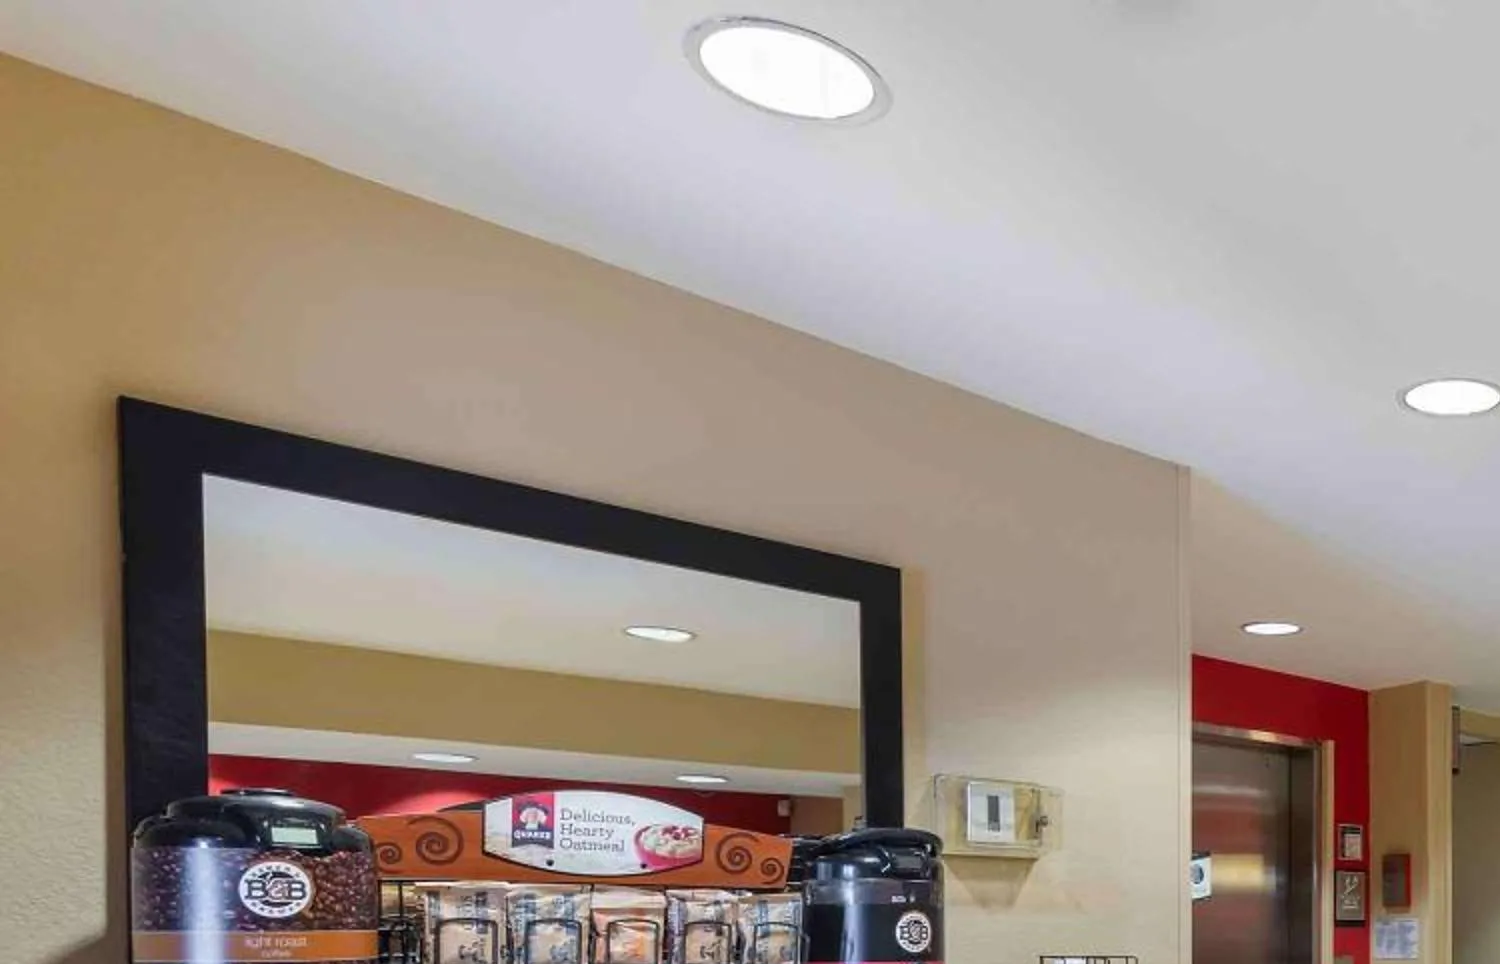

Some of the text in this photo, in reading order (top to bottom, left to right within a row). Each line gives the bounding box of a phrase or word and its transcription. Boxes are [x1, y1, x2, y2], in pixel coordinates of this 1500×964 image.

[560, 808, 636, 826] Delicious,
[560, 823, 614, 839] Hearty
[560, 838, 624, 852] Oatmeal
